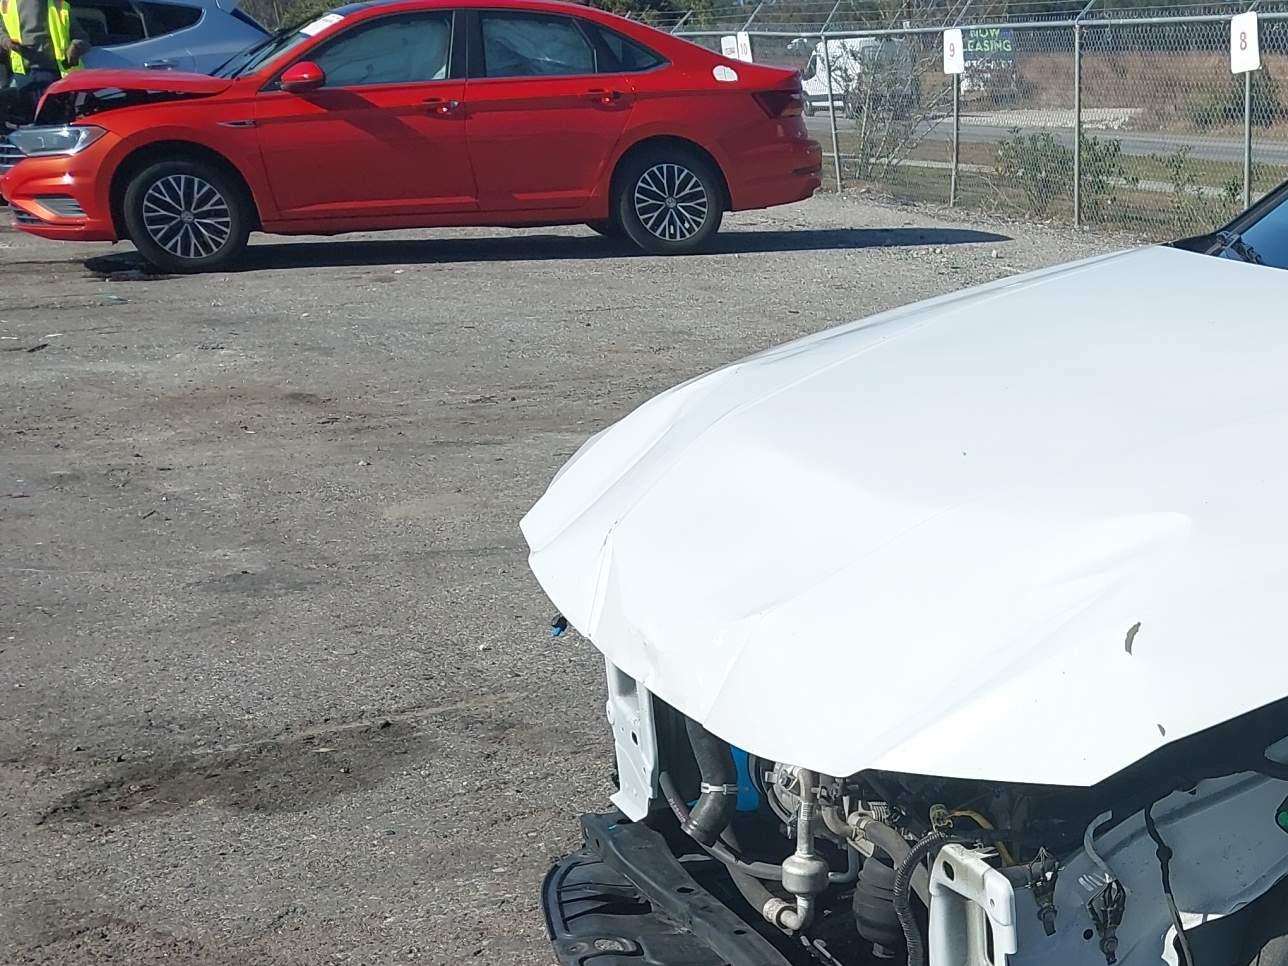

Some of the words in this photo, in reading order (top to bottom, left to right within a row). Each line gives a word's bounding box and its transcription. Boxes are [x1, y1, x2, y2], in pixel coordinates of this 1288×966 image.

[963, 39, 1012, 52] EASING
[1240, 31, 1248, 51] 8
[949, 42, 956, 57] 9
